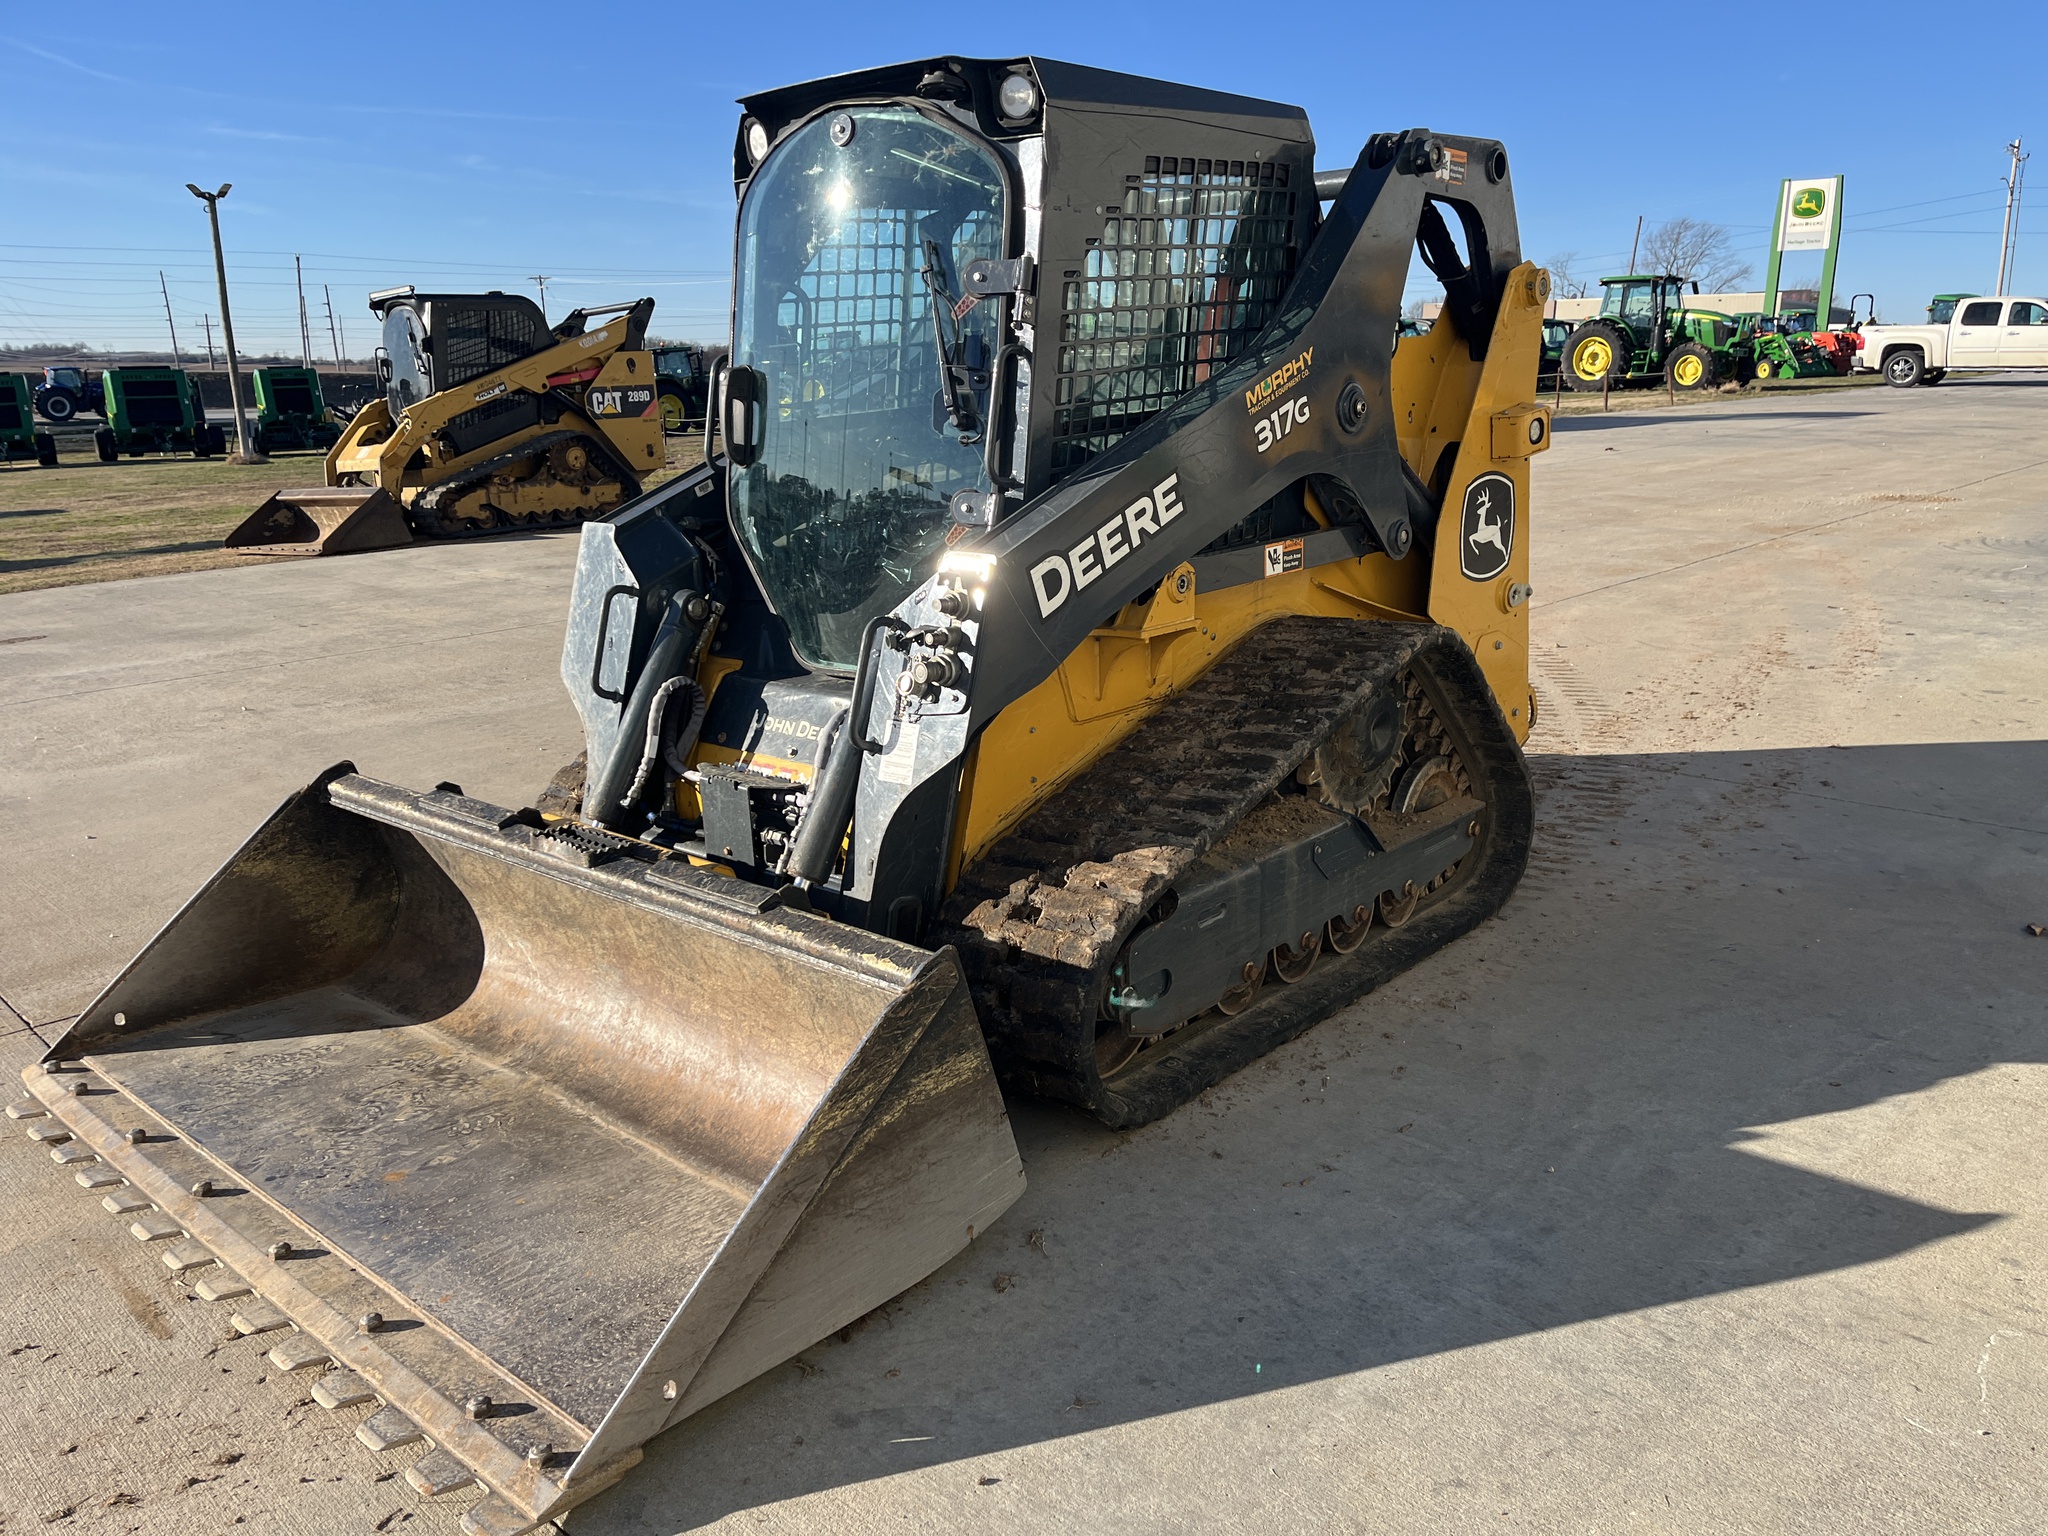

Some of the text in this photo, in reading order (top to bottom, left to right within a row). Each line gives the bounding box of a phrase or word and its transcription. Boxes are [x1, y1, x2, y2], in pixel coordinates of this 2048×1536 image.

[592, 390, 651, 415] CAT 289D
[1245, 345, 1314, 409] MURPHY
[1248, 396, 1272, 416] TRACTOR
[1275, 373, 1302, 398] EQUIPMENT
[1301, 368, 1311, 379] CO.
[1254, 395, 1311, 453] 317G
[1029, 472, 1184, 619] DEERE
